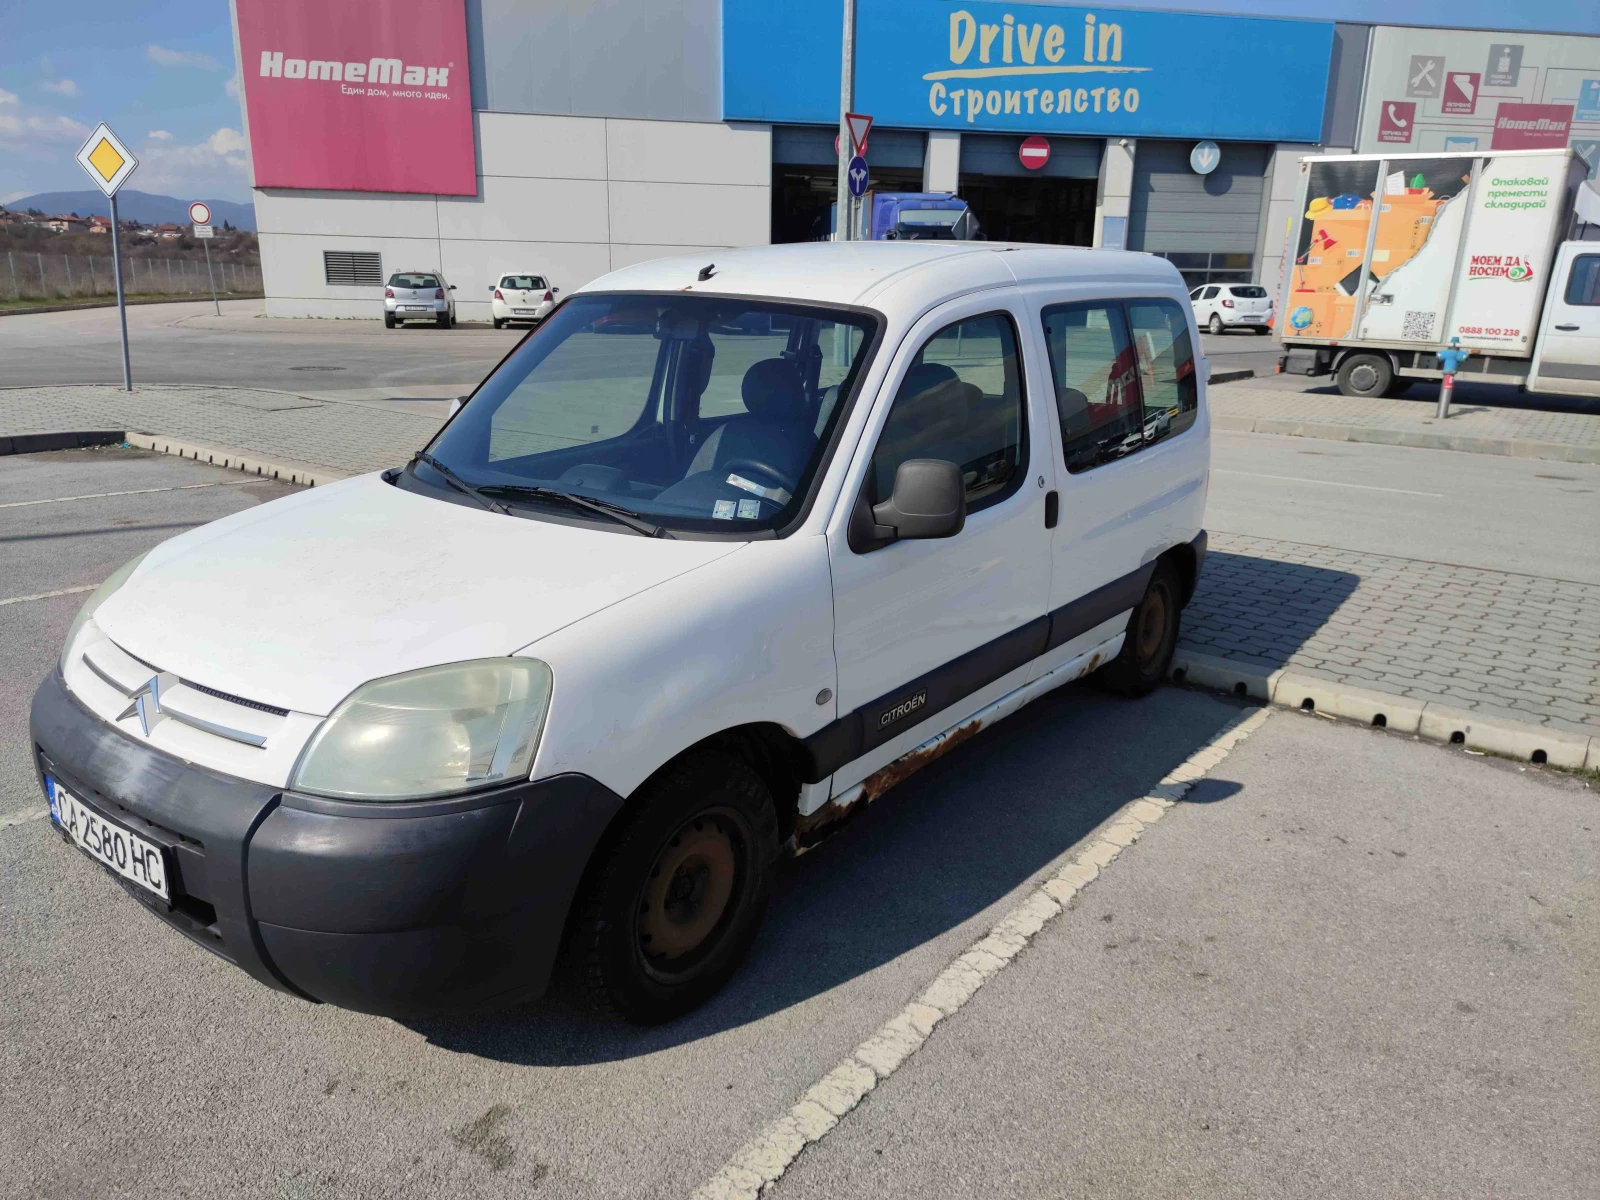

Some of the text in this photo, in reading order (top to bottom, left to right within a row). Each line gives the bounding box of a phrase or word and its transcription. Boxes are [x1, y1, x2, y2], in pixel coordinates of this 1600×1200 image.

[949, 10, 1122, 64] Drive in
[260, 51, 449, 87] HomeMax
[341, 84, 451, 100] Един дом, много идеи.
[929, 82, 1139, 123] Строителство
[1497, 117, 1567, 131] HomeMax
[1491, 177, 1549, 186] Опаковай
[1487, 190, 1548, 199] премести
[1484, 200, 1546, 210] складирай
[1470, 256, 1520, 266] МОЕМ ДА
[1468, 266, 1509, 276] НОСИМ
[1459, 326, 1482, 334] 0888
[1503, 329, 1520, 337] 238
[881, 693, 926, 725] CITROËN
[80, 810, 127, 870] 2580
